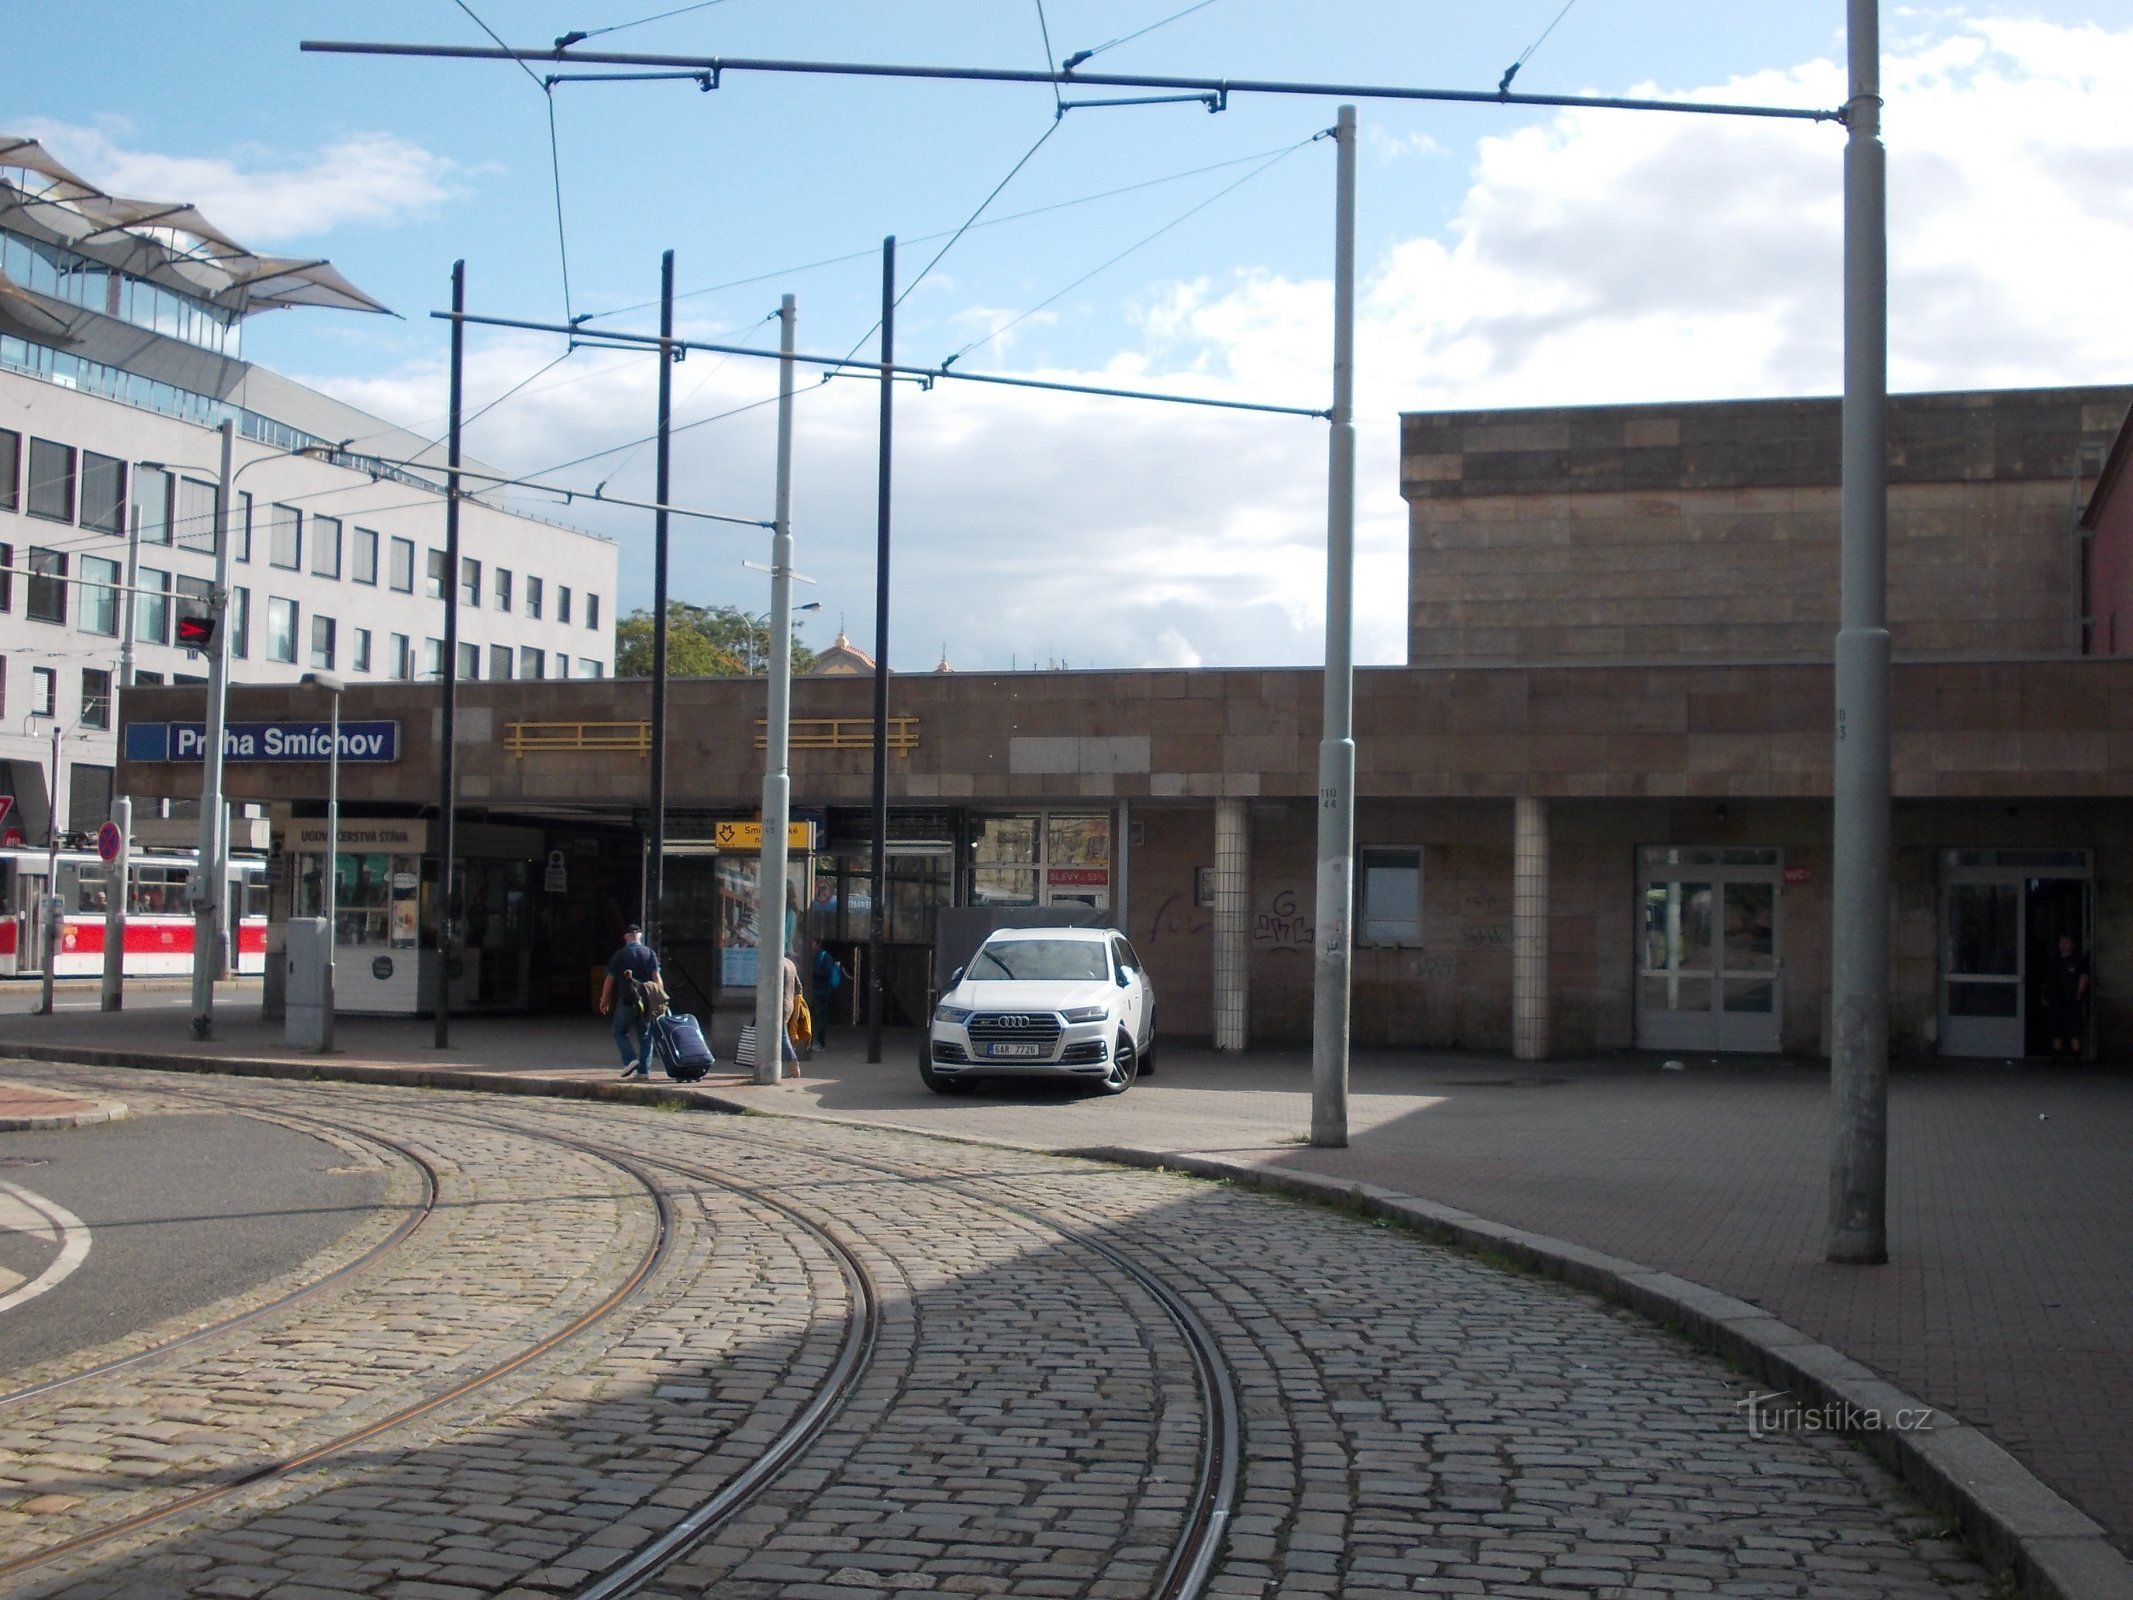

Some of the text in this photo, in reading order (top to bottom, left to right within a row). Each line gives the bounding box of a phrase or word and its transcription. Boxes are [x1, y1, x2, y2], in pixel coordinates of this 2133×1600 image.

[177, 727, 383, 755] Prha Smíchov
[1784, 868, 1806, 881] WC
[1015, 1045, 1036, 1054] 7726
